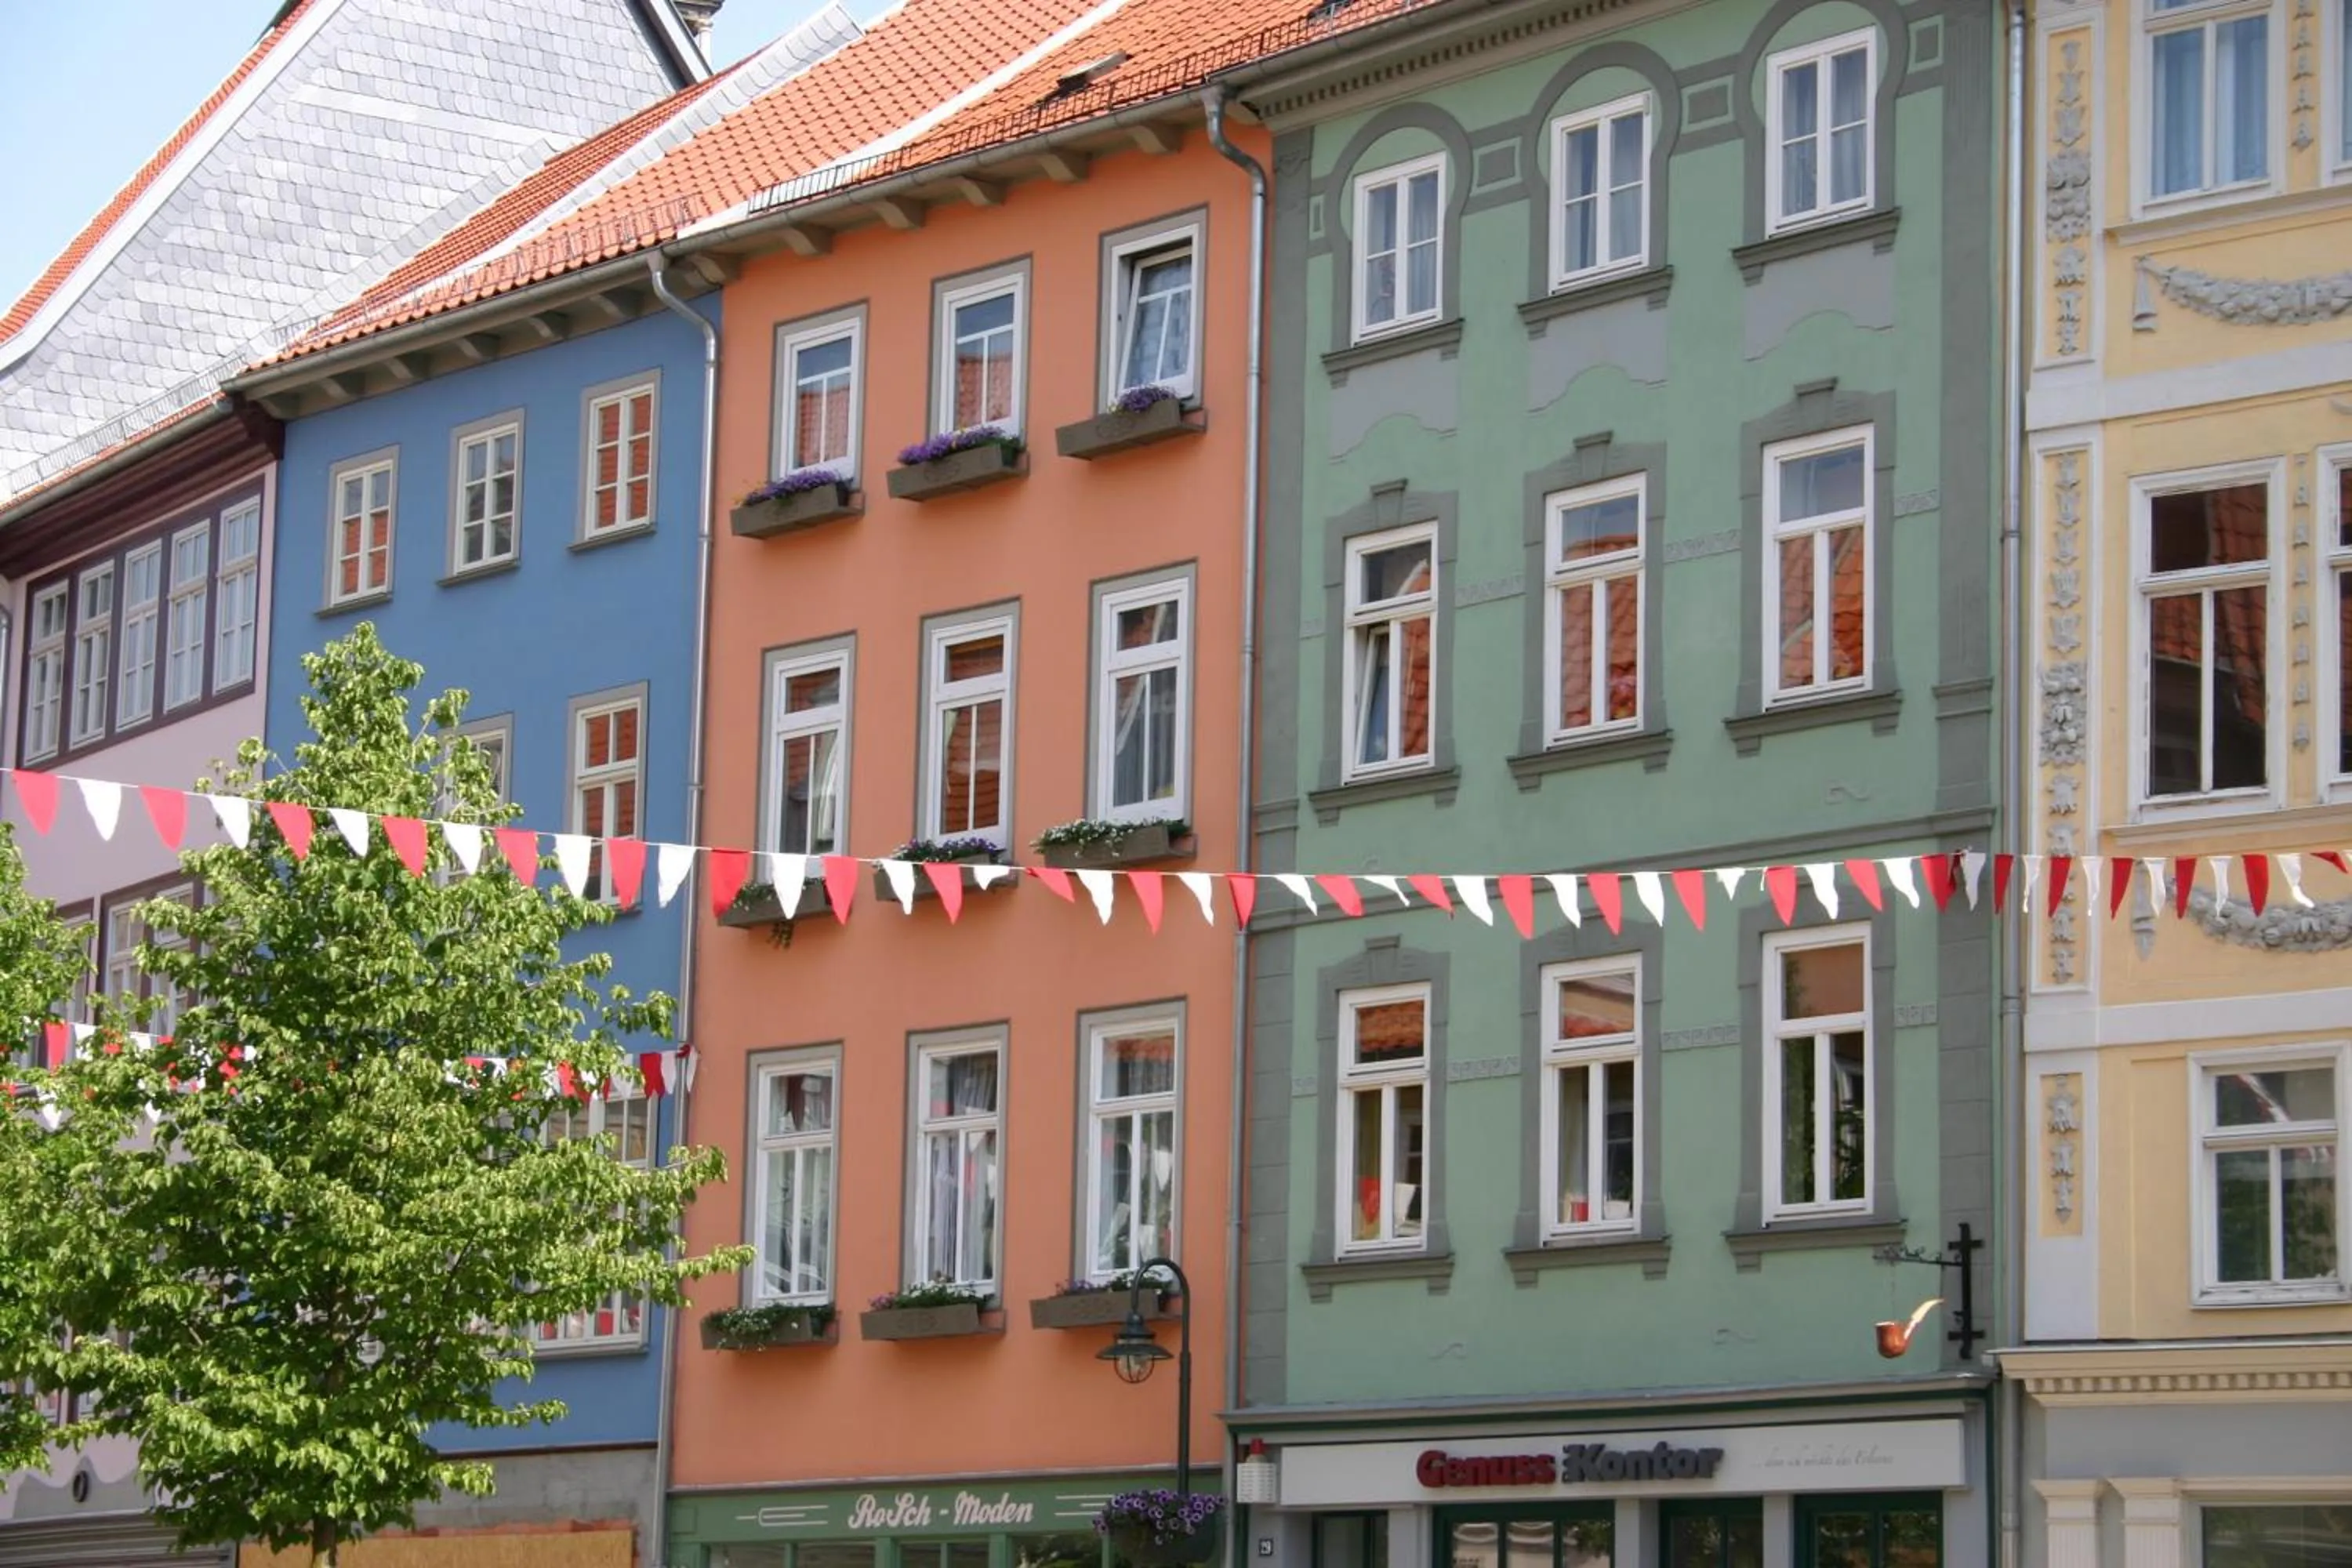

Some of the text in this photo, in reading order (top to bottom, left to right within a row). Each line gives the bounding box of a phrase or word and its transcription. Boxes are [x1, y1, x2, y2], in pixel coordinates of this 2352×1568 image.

[1417, 1450, 1556, 1488] Genuss
[1566, 1441, 1725, 1483] Kontor
[953, 1490, 1034, 1526] Moden
